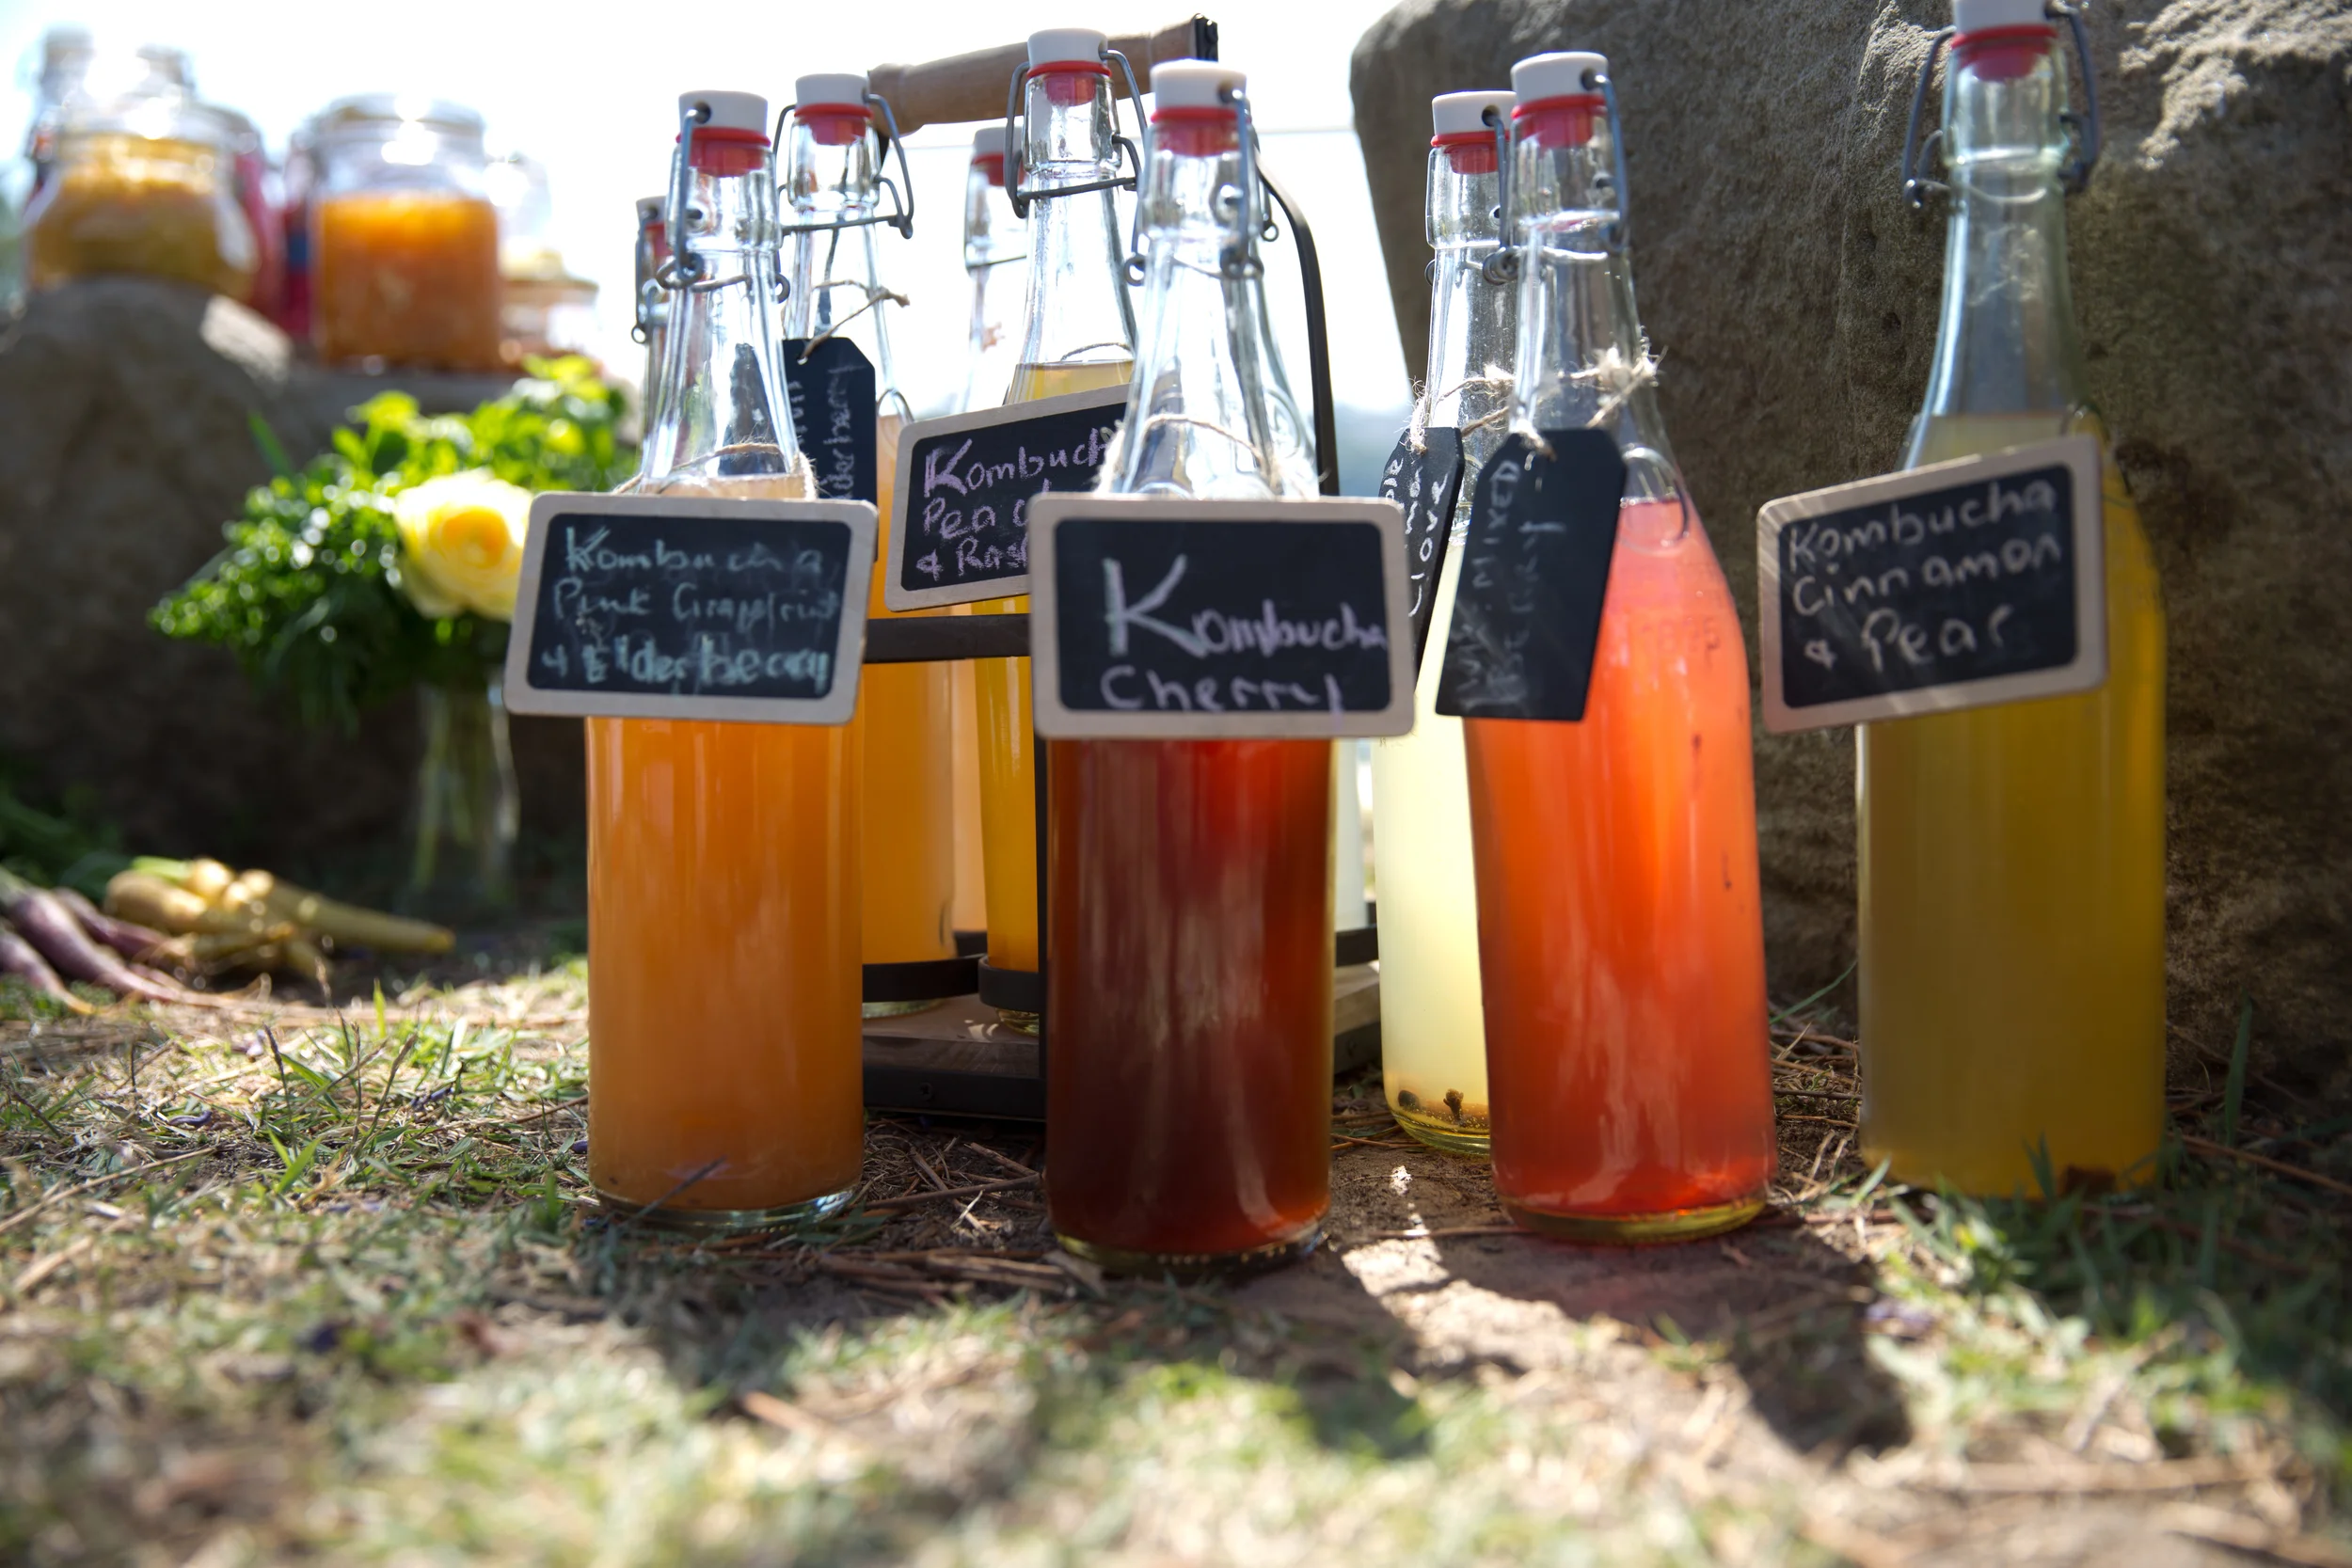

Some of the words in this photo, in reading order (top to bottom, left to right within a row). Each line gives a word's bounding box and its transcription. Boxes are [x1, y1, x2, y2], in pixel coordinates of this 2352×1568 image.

[566, 528, 822, 573] Kombucha
[1789, 480, 2057, 572] Kombucha
[554, 578, 651, 620] Pink
[1102, 554, 1387, 658] Kombucha
[1792, 533, 2061, 615] Cinnamon
[1861, 604, 2014, 673] Pear
[1101, 664, 1343, 730] Cherry
